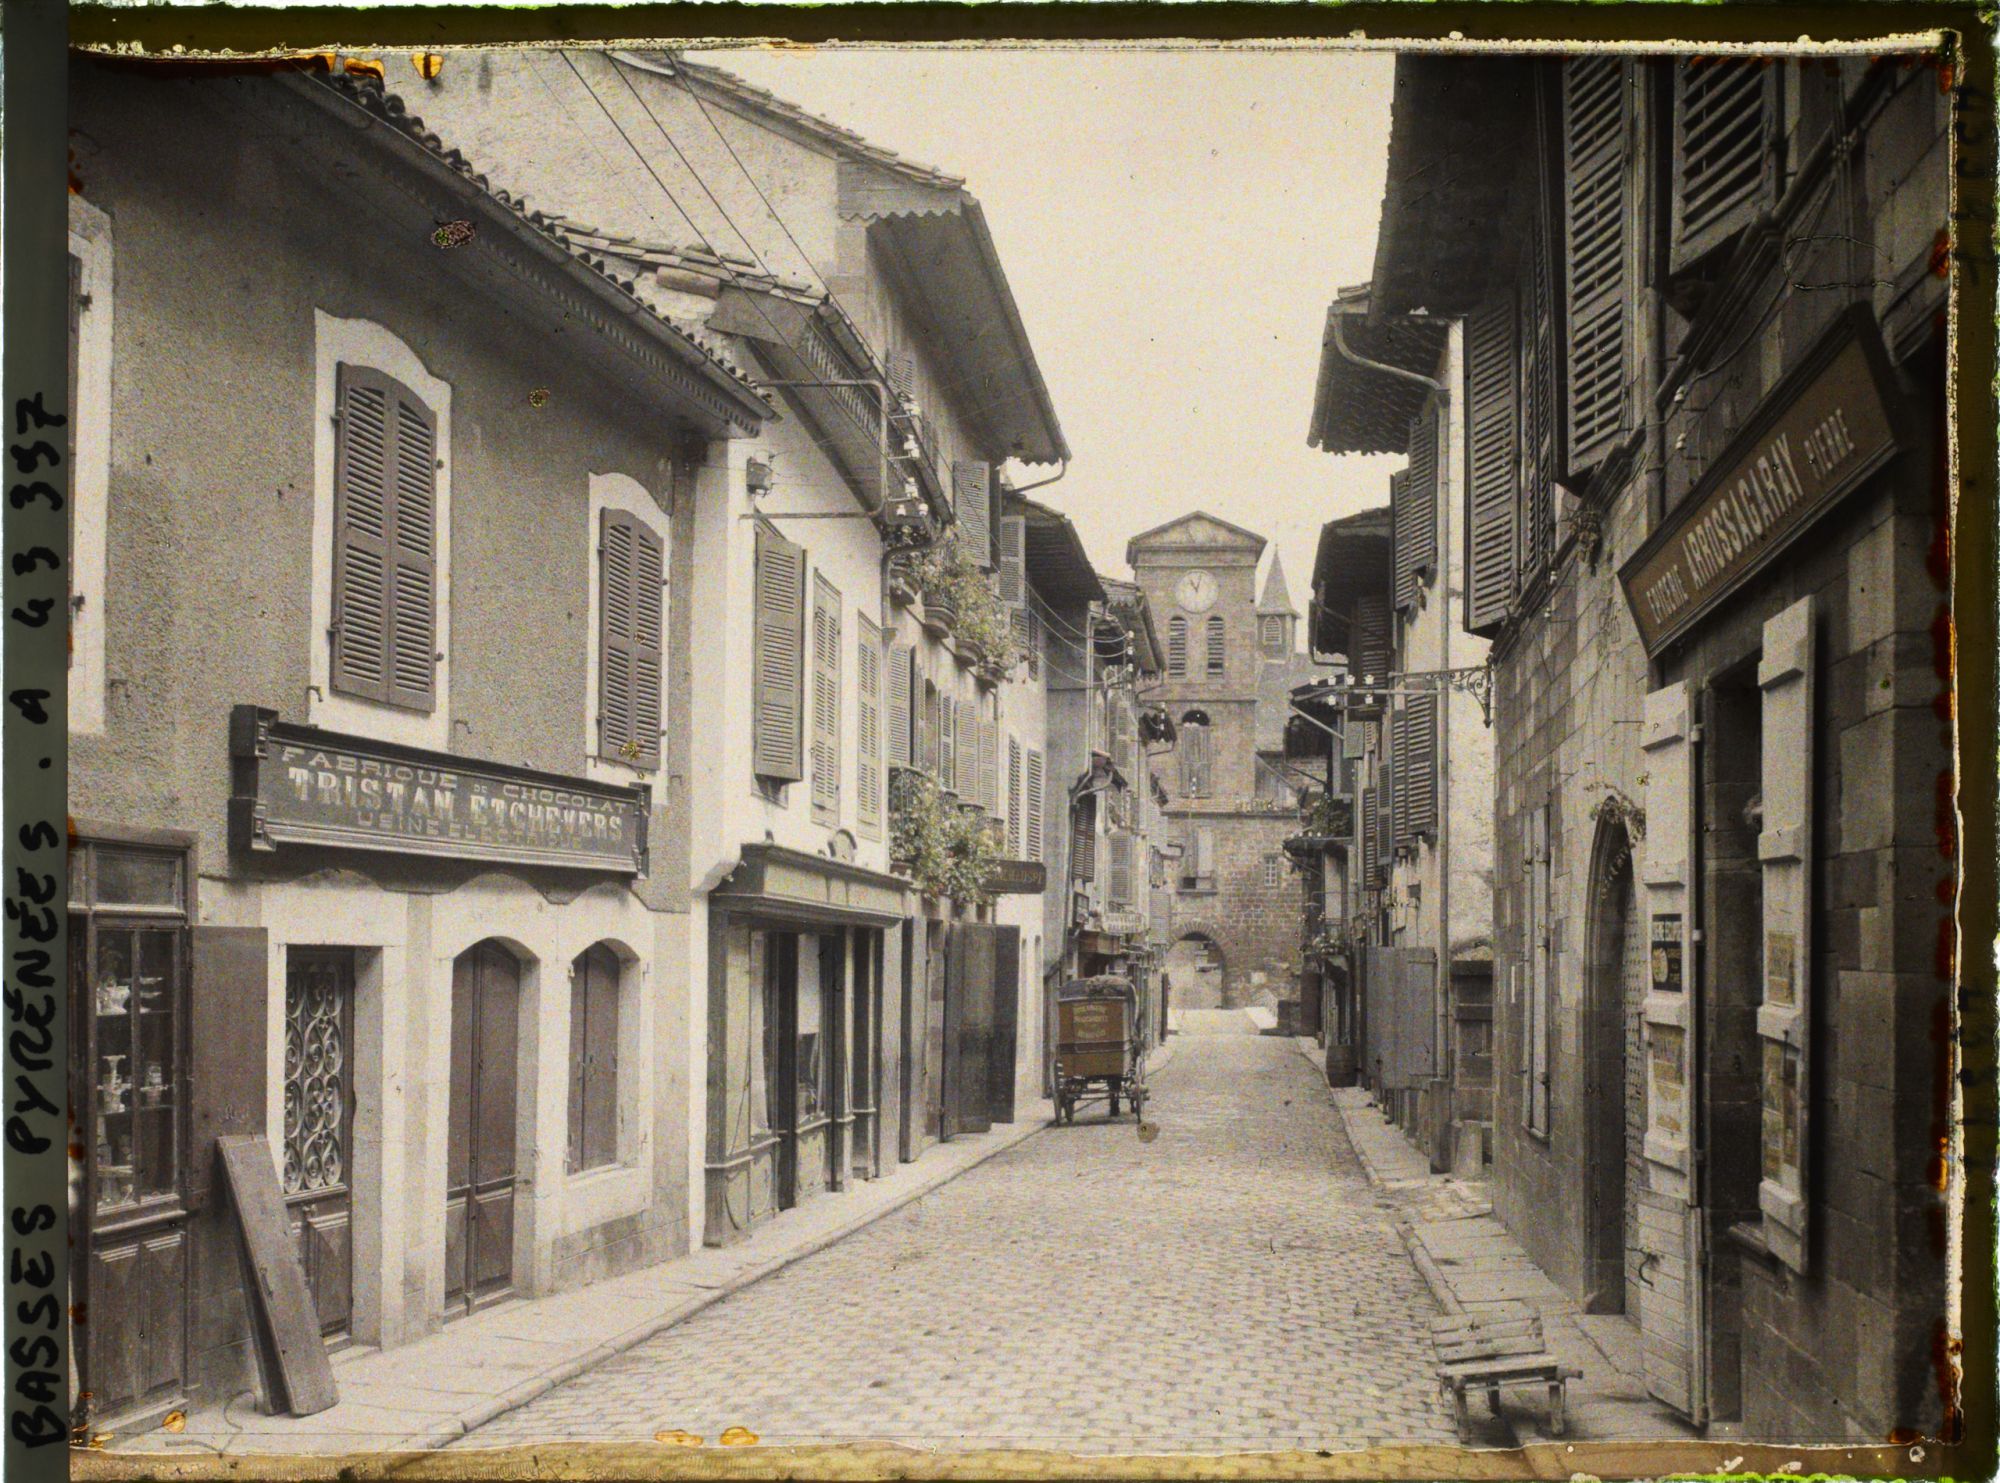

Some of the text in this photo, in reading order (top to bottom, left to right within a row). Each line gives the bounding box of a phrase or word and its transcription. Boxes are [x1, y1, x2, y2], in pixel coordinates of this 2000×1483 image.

[1681, 432, 1804, 591] ARROSSAGARAY
[281, 745, 458, 790] FABRIQUE
[502, 784, 627, 815] CHOCOLAT
[288, 765, 624, 843] TRISTAN ETCHEVERS
[358, 810, 441, 836] USINE
